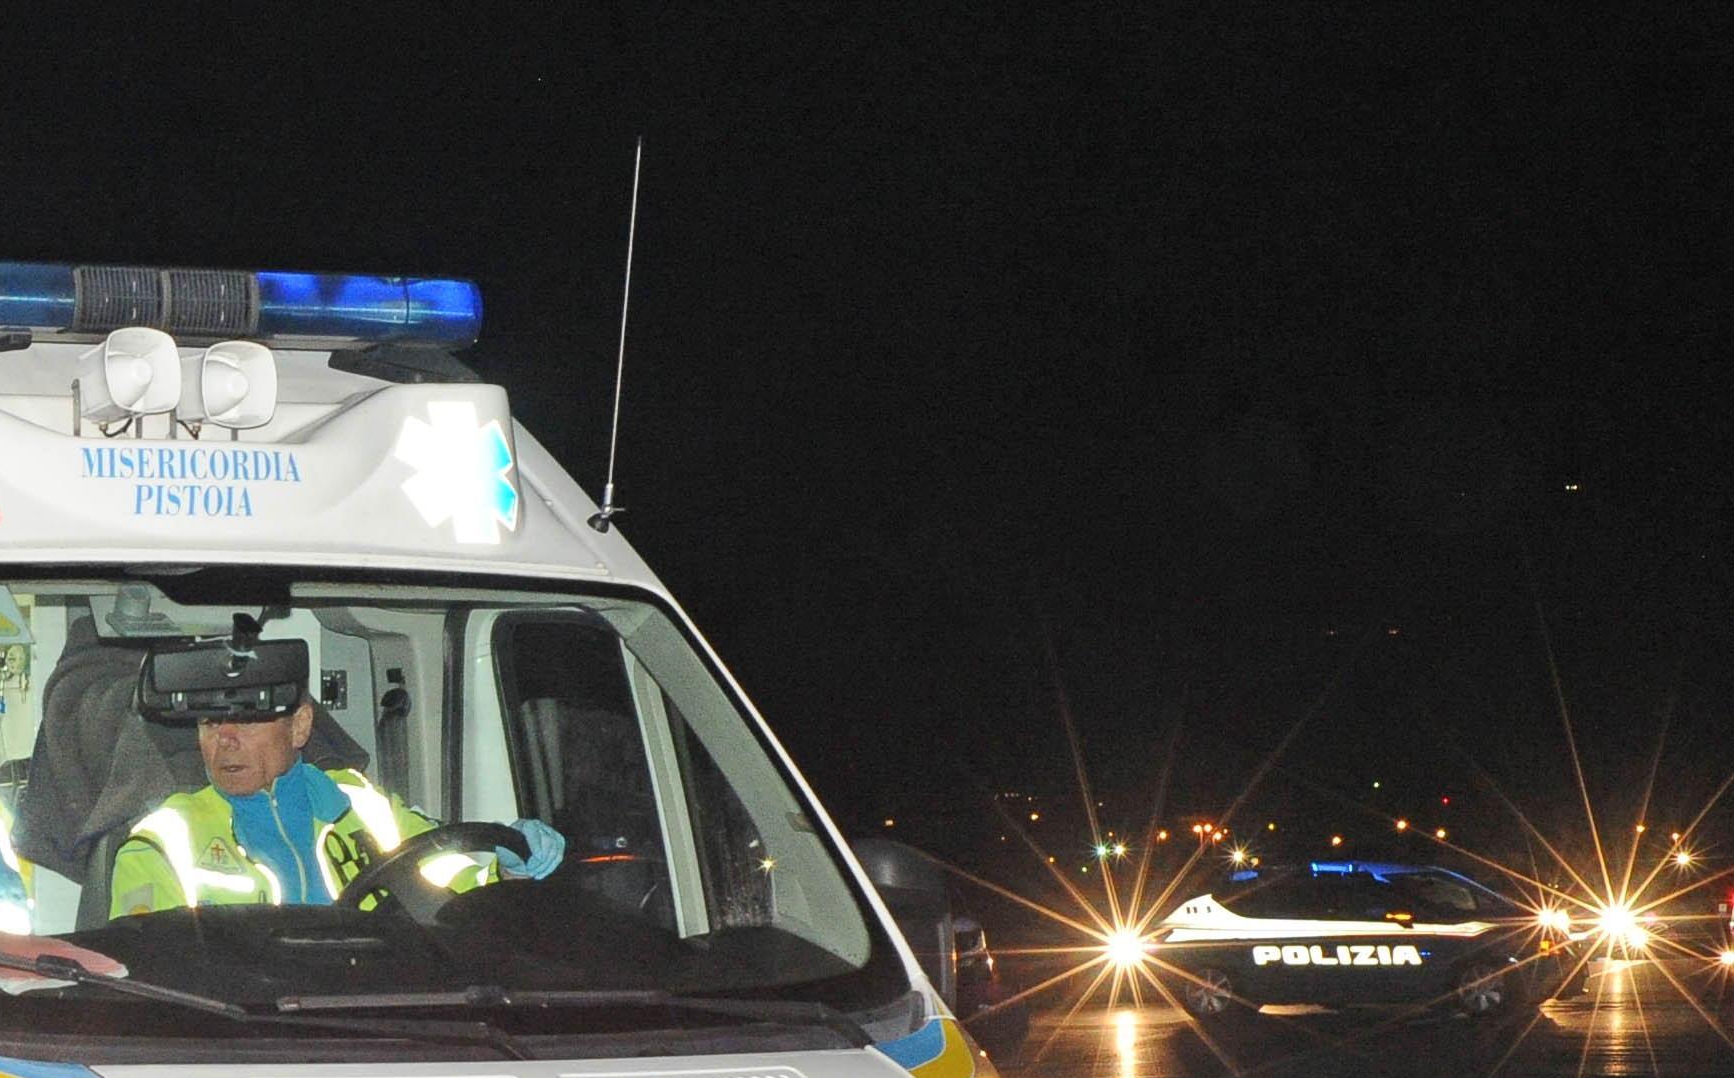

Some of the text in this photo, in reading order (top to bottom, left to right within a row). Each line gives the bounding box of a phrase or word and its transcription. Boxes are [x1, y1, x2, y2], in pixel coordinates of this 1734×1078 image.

[81, 447, 302, 482] MISERICORDIA
[134, 484, 253, 517] PISTOIA
[1252, 945, 1423, 966] POLIZIA
